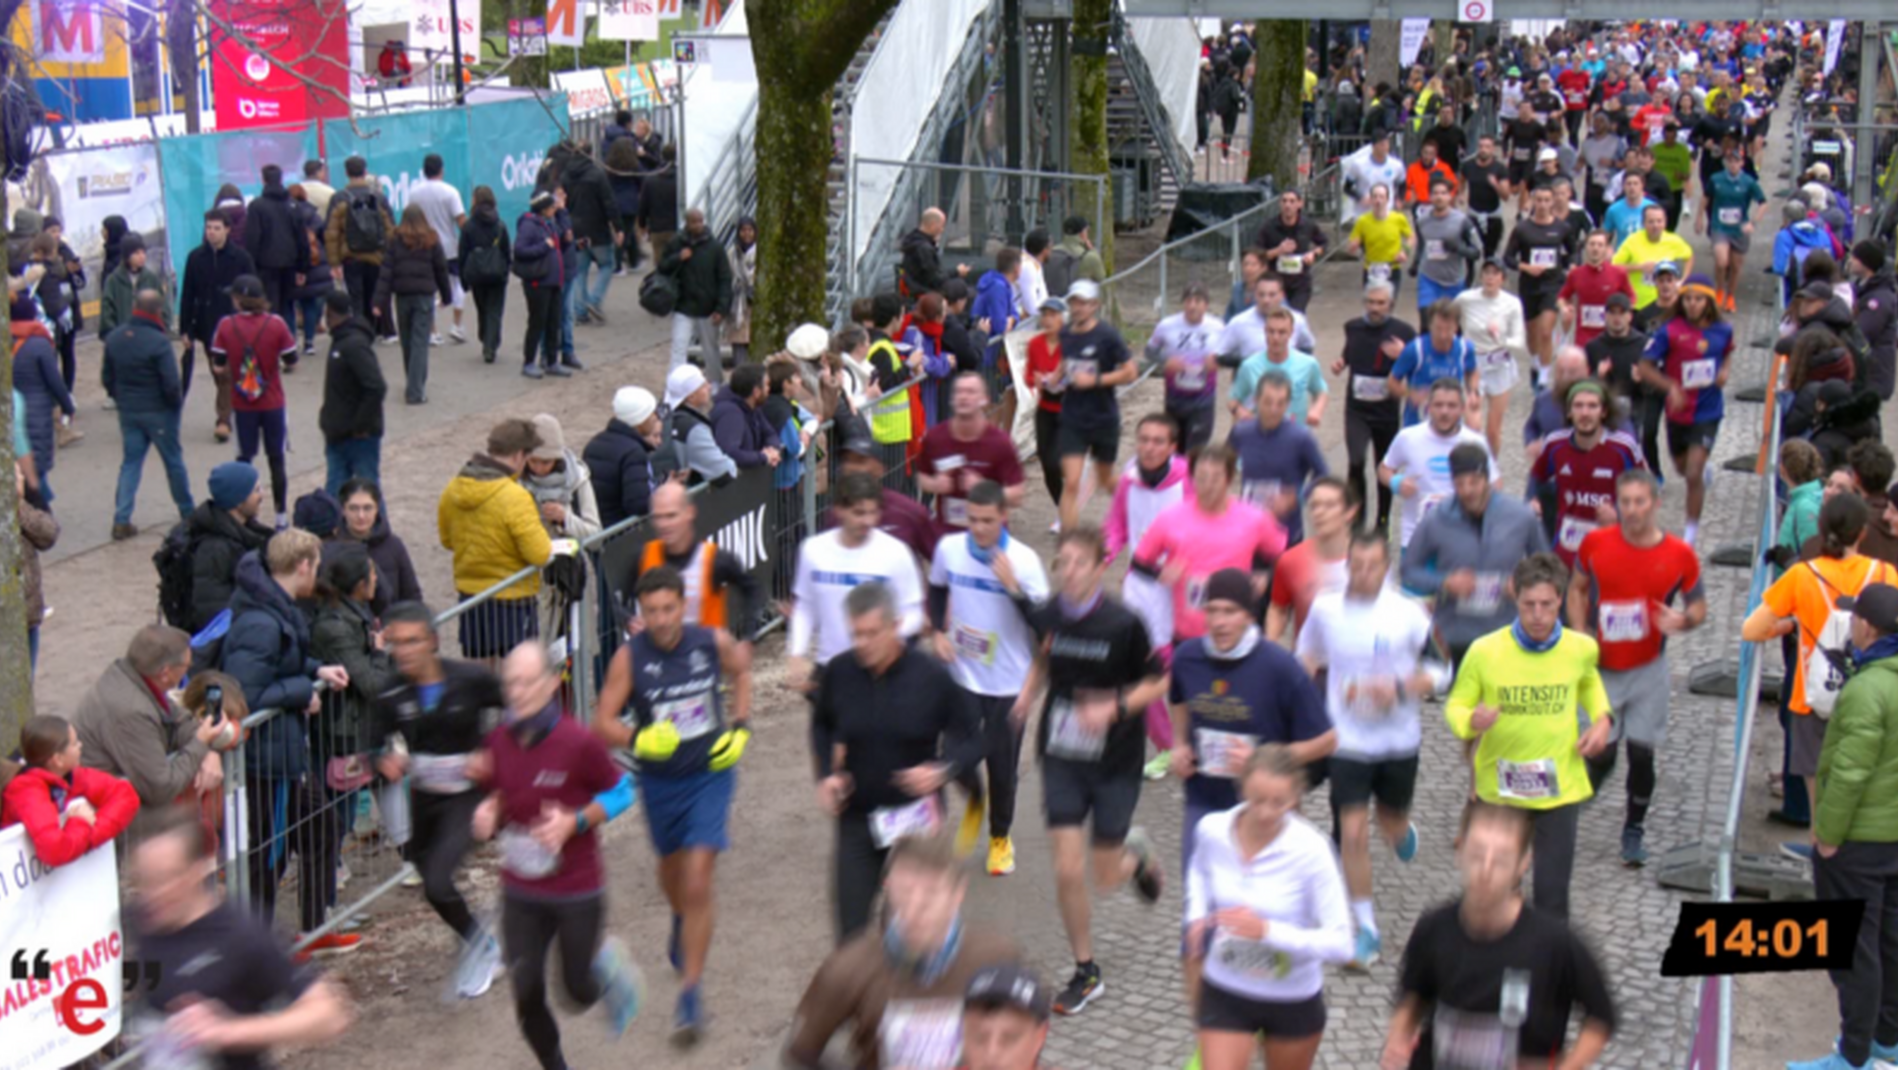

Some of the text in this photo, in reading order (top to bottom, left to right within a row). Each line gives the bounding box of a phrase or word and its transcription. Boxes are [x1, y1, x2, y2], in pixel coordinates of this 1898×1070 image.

[438, 17, 473, 34] US
[1576, 491, 1612, 507] MSC
[1497, 684, 1569, 702] INTENSITY
